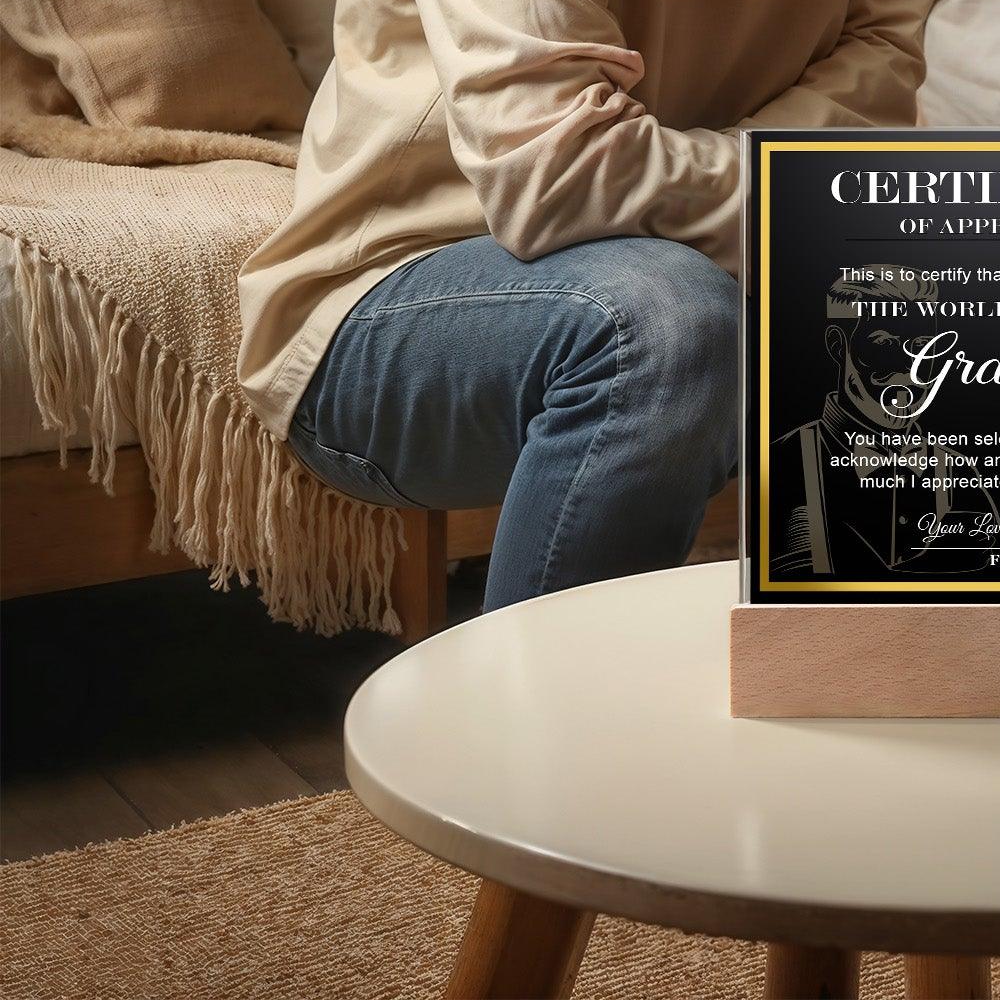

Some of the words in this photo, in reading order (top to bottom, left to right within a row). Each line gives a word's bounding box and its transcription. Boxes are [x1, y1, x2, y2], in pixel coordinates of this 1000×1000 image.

[899, 218, 934, 234] OF
[839, 267, 875, 282] This
[880, 267, 894, 282] is
[899, 267, 915, 282] to
[921, 267, 972, 285] certify
[851, 301, 908, 317] THE
[844, 431, 875, 446] You
[881, 431, 922, 446] have
[927, 431, 968, 446] been
[830, 452, 939, 471] acknowledge
[944, 452, 979, 467] how
[860, 474, 905, 489] much
[911, 474, 915, 488] I
[916, 511, 966, 544] Your
